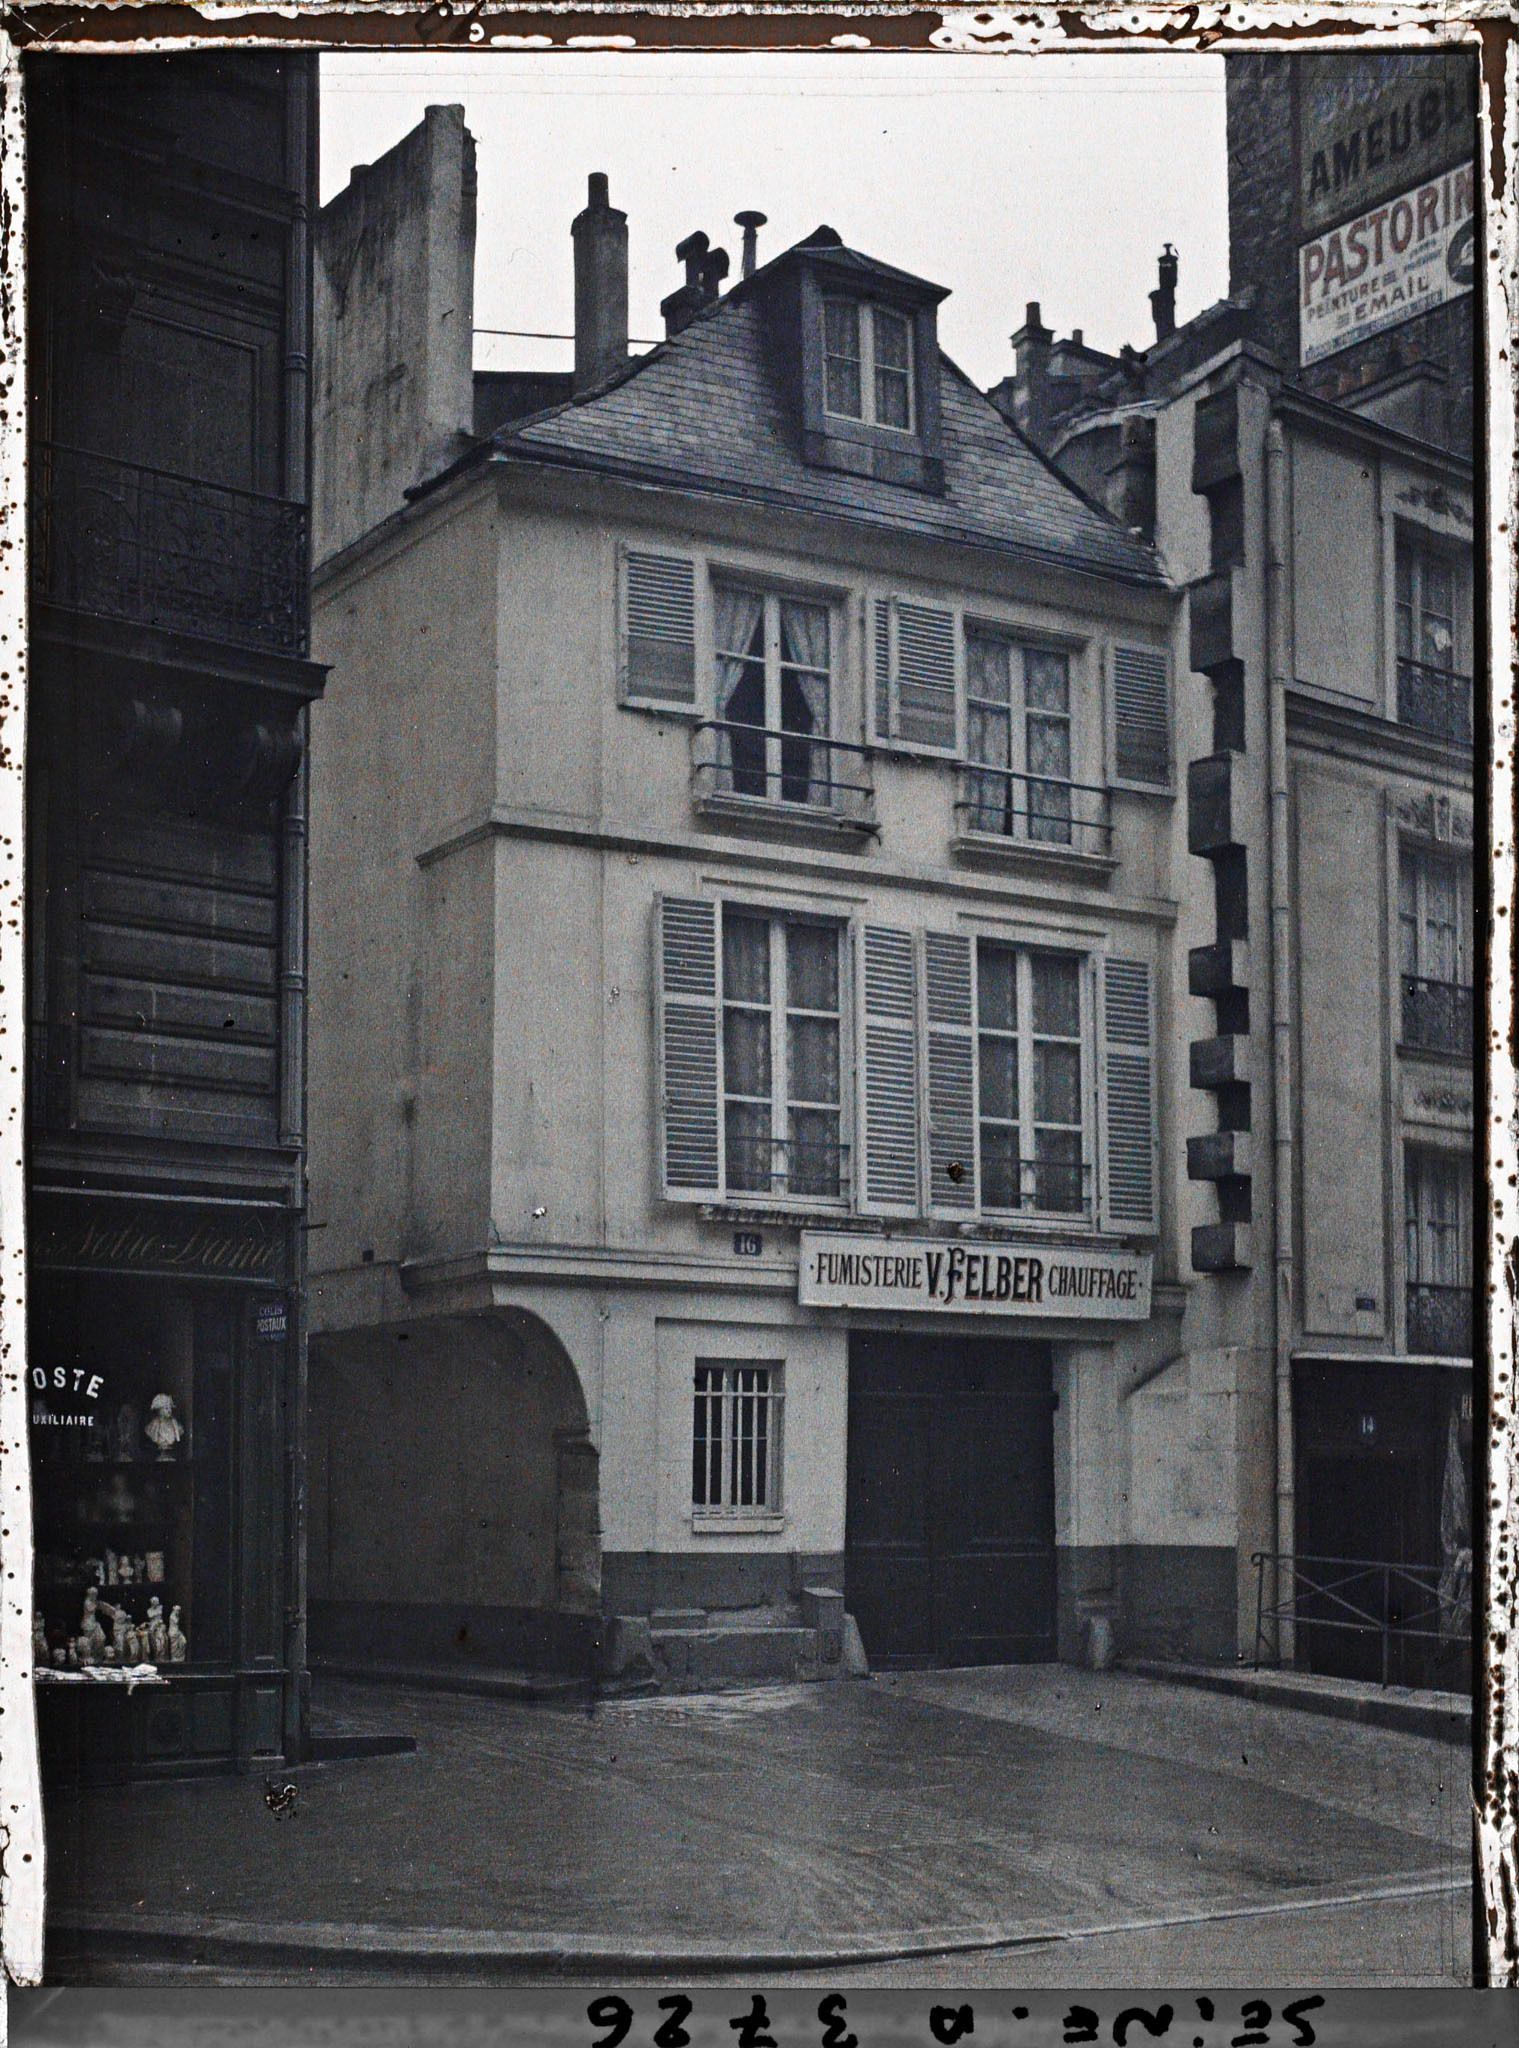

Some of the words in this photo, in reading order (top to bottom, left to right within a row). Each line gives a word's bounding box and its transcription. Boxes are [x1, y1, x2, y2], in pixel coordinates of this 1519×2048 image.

[740, 1235, 757, 1254] 16
[815, 1252, 922, 1288] FUMISTERIE
[943, 1247, 1045, 1305] FELBER
[1047, 1264, 1138, 1300] CHAUFFAGE
[1361, 1415, 1375, 1434] 14
